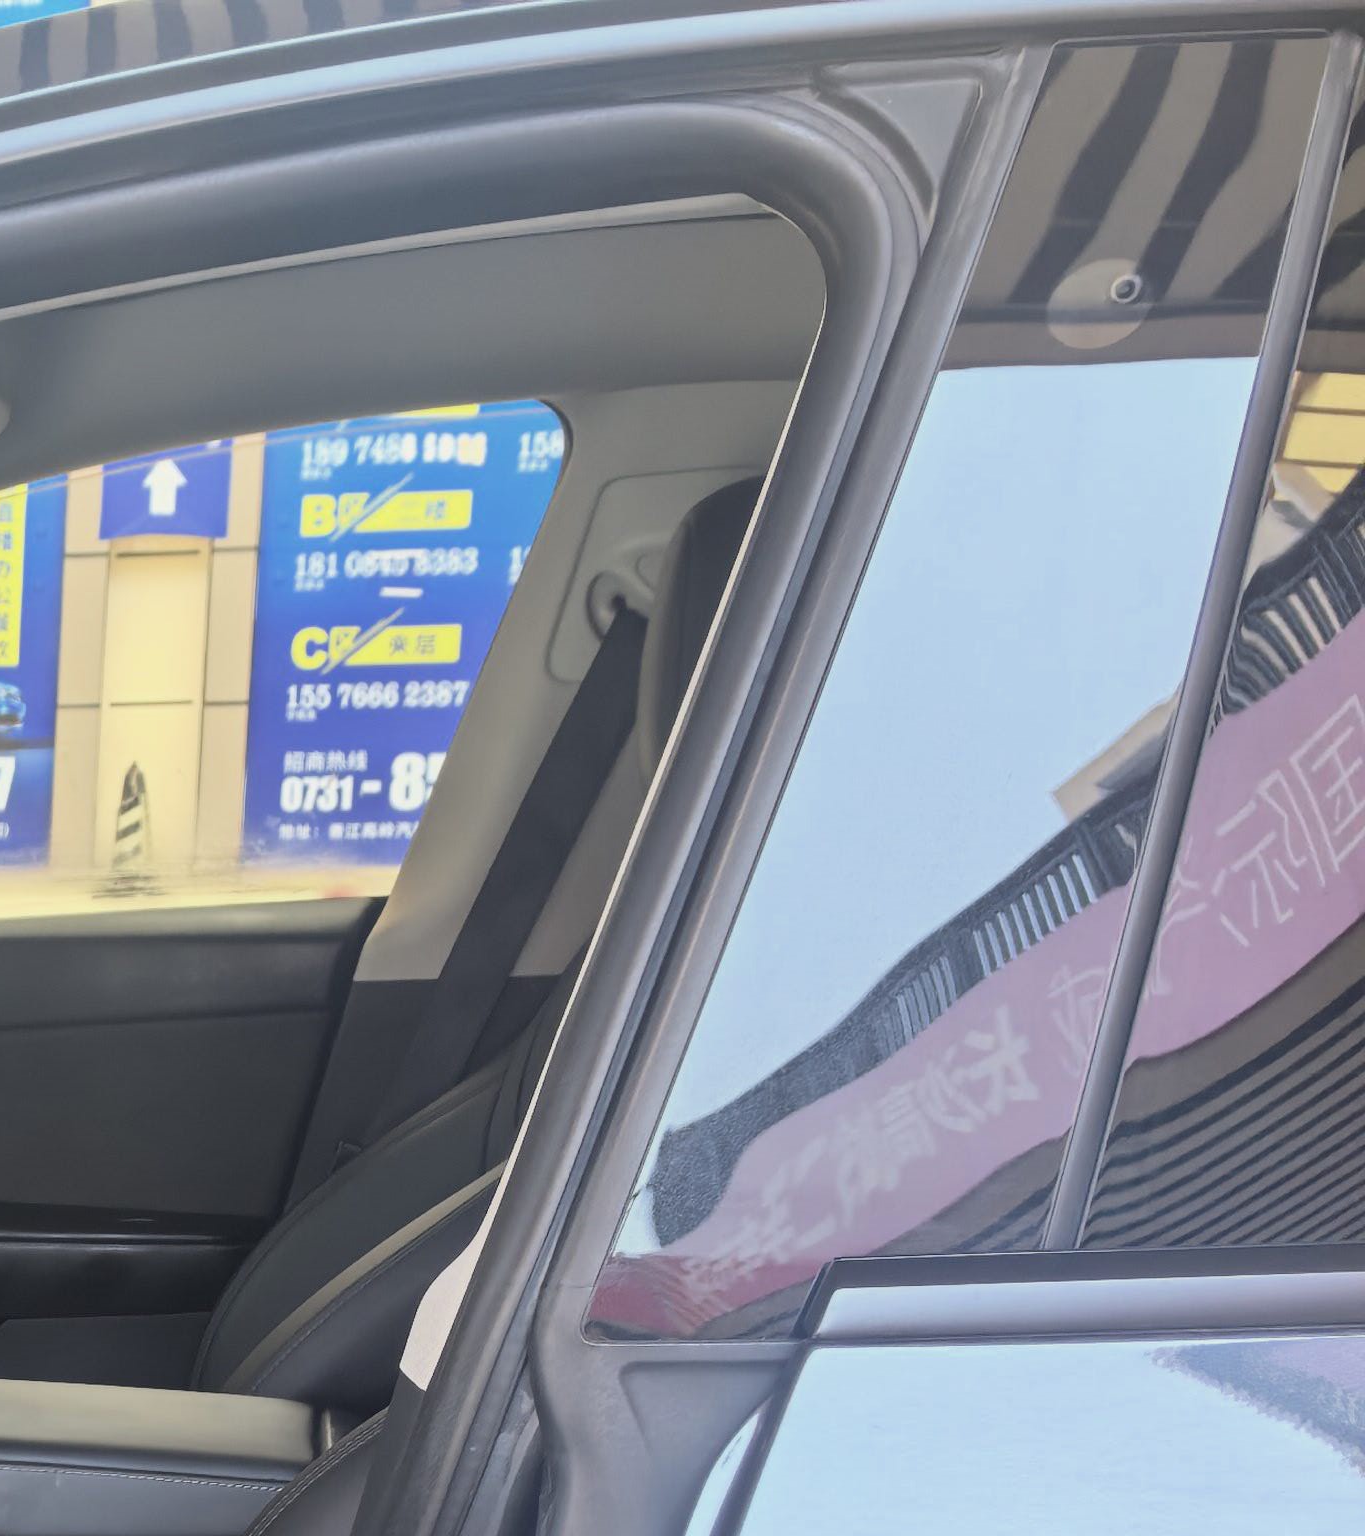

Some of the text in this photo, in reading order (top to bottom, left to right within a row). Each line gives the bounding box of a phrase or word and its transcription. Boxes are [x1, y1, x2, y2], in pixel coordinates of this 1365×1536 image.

[283, 750, 368, 773] 招商热线
[280, 775, 354, 813] 0731
